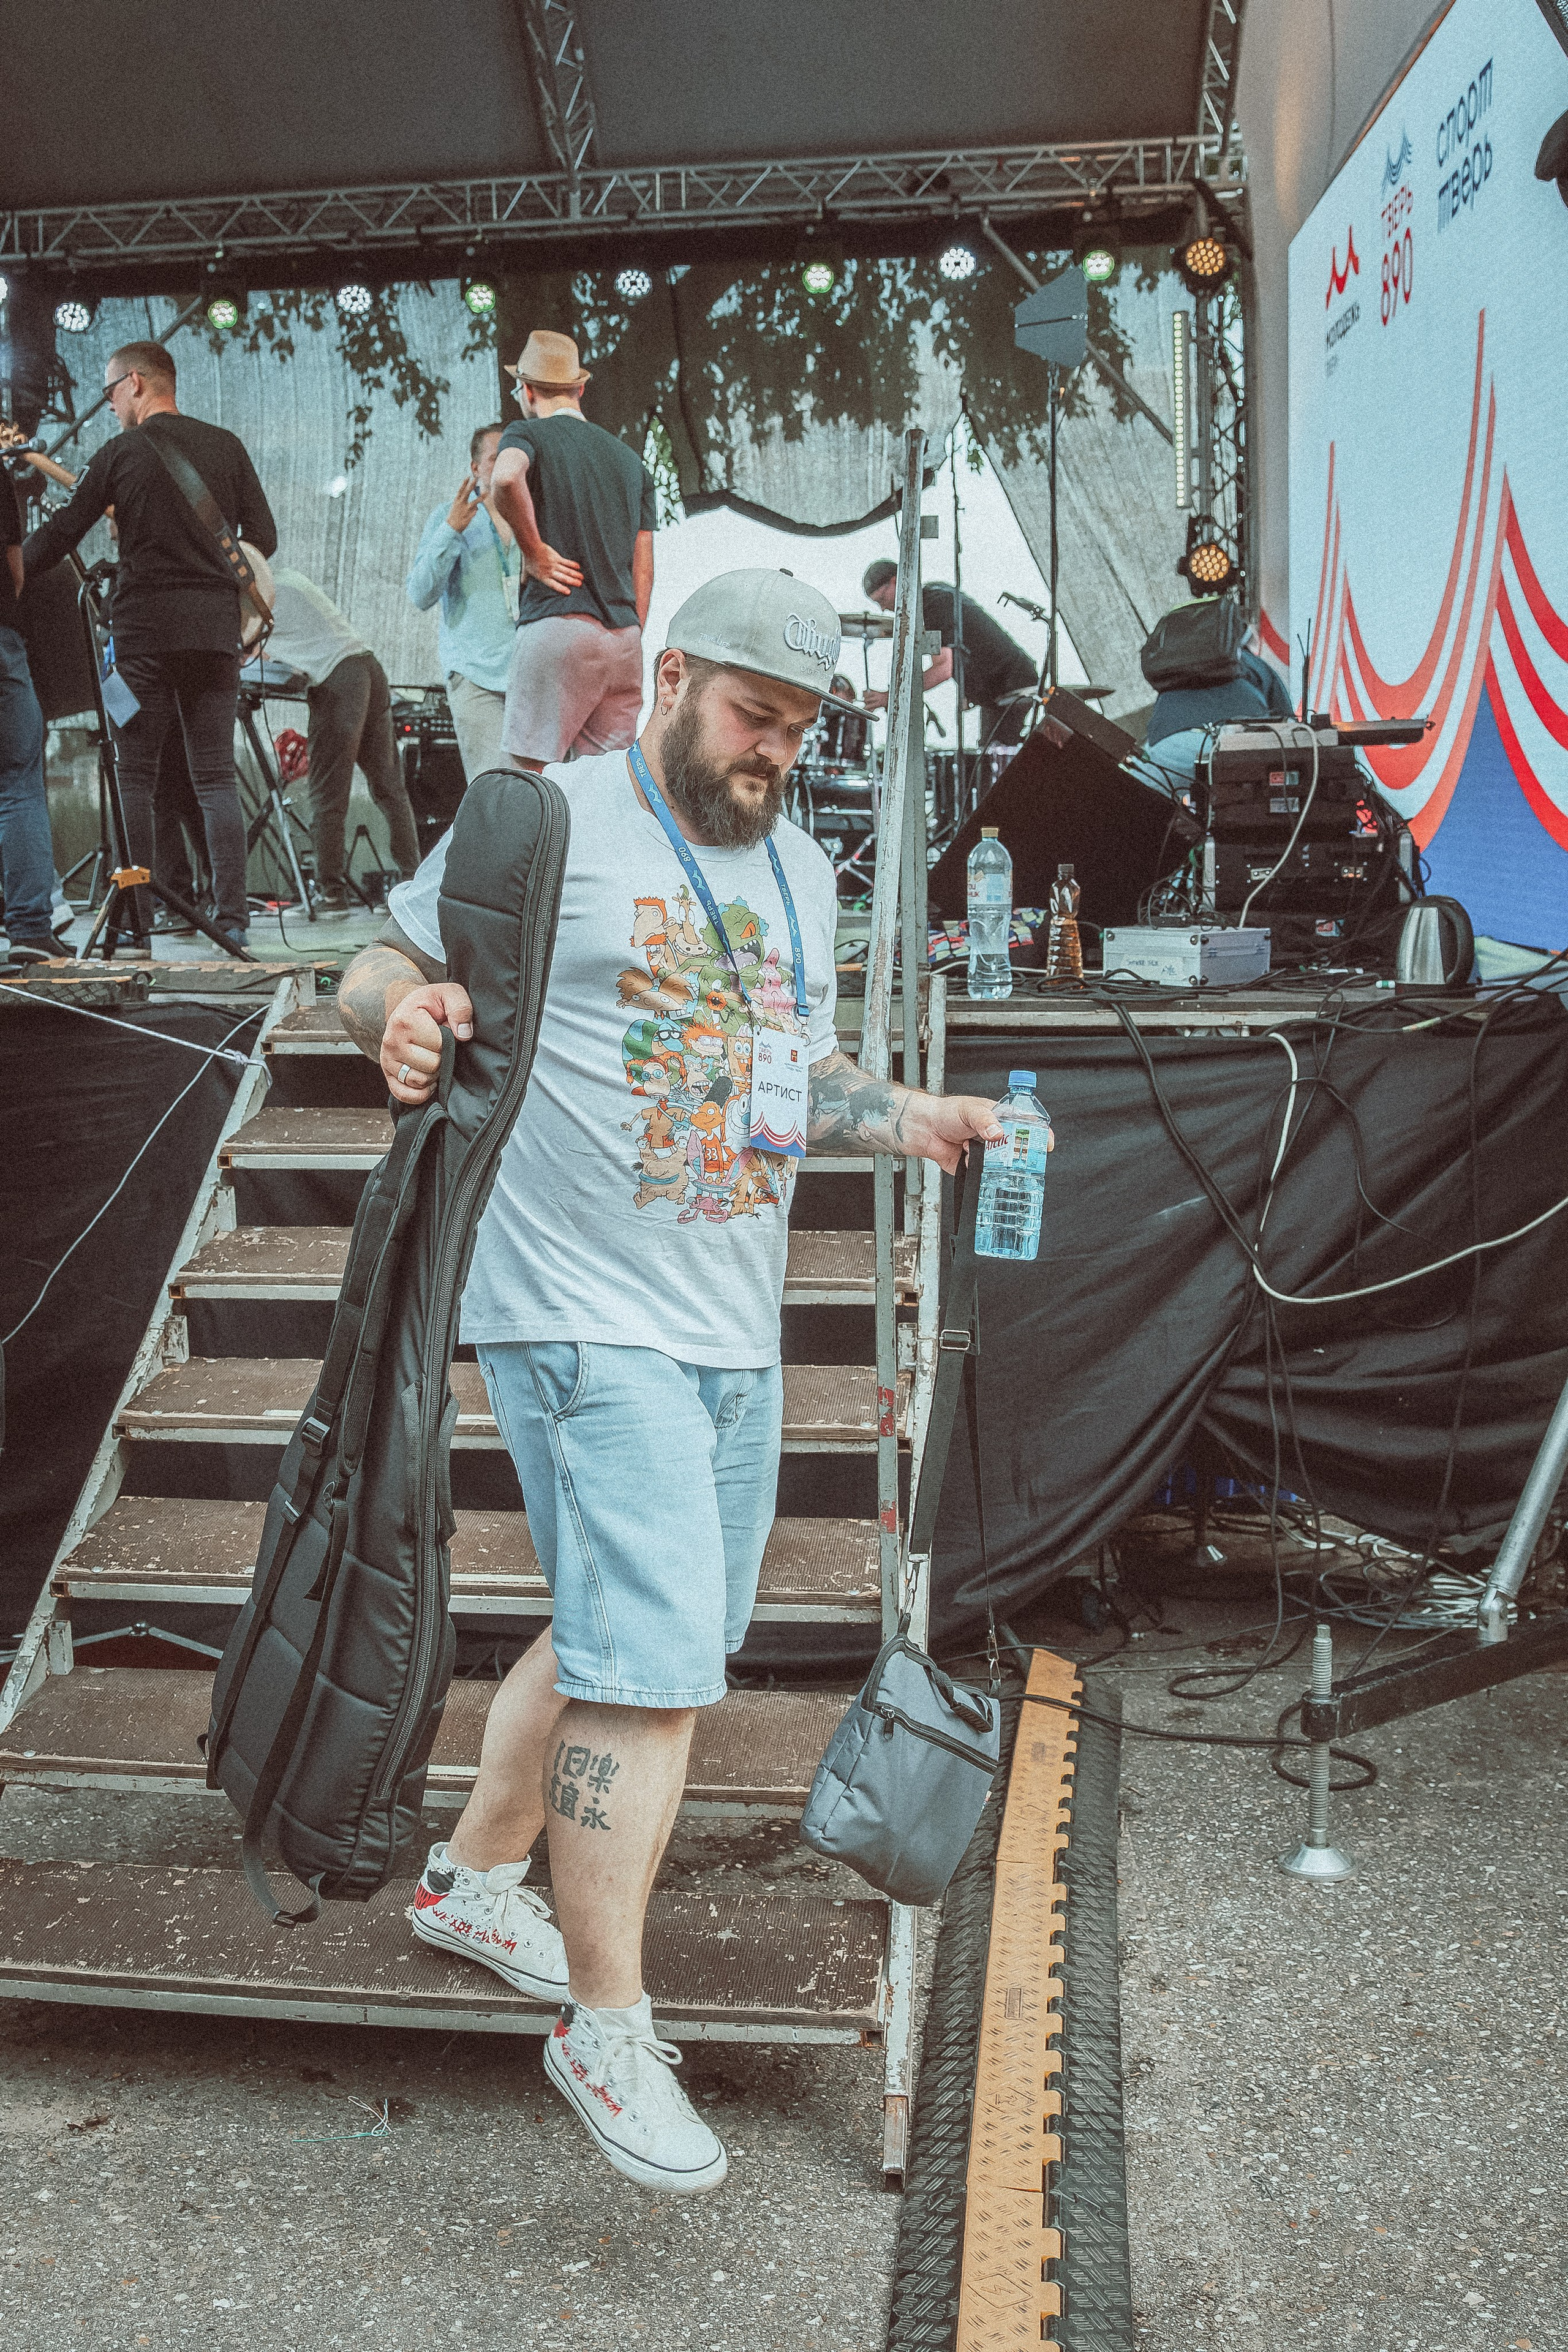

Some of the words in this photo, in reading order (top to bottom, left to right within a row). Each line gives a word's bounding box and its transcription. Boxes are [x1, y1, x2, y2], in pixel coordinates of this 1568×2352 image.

[1382, 181, 1414, 245] ТВЕРЬ
[1381, 227, 1413, 326] 890
[636, 757, 647, 777] ТВЕРЬ
[678, 846, 691, 862] 890
[780, 883, 791, 906] ТВЕРЬ
[706, 900, 719, 926] ТВЕРЬ
[758, 1053, 772, 1064] 890
[758, 1080, 802, 1102] АРТИСТ
[706, 1147, 718, 1161] 33
